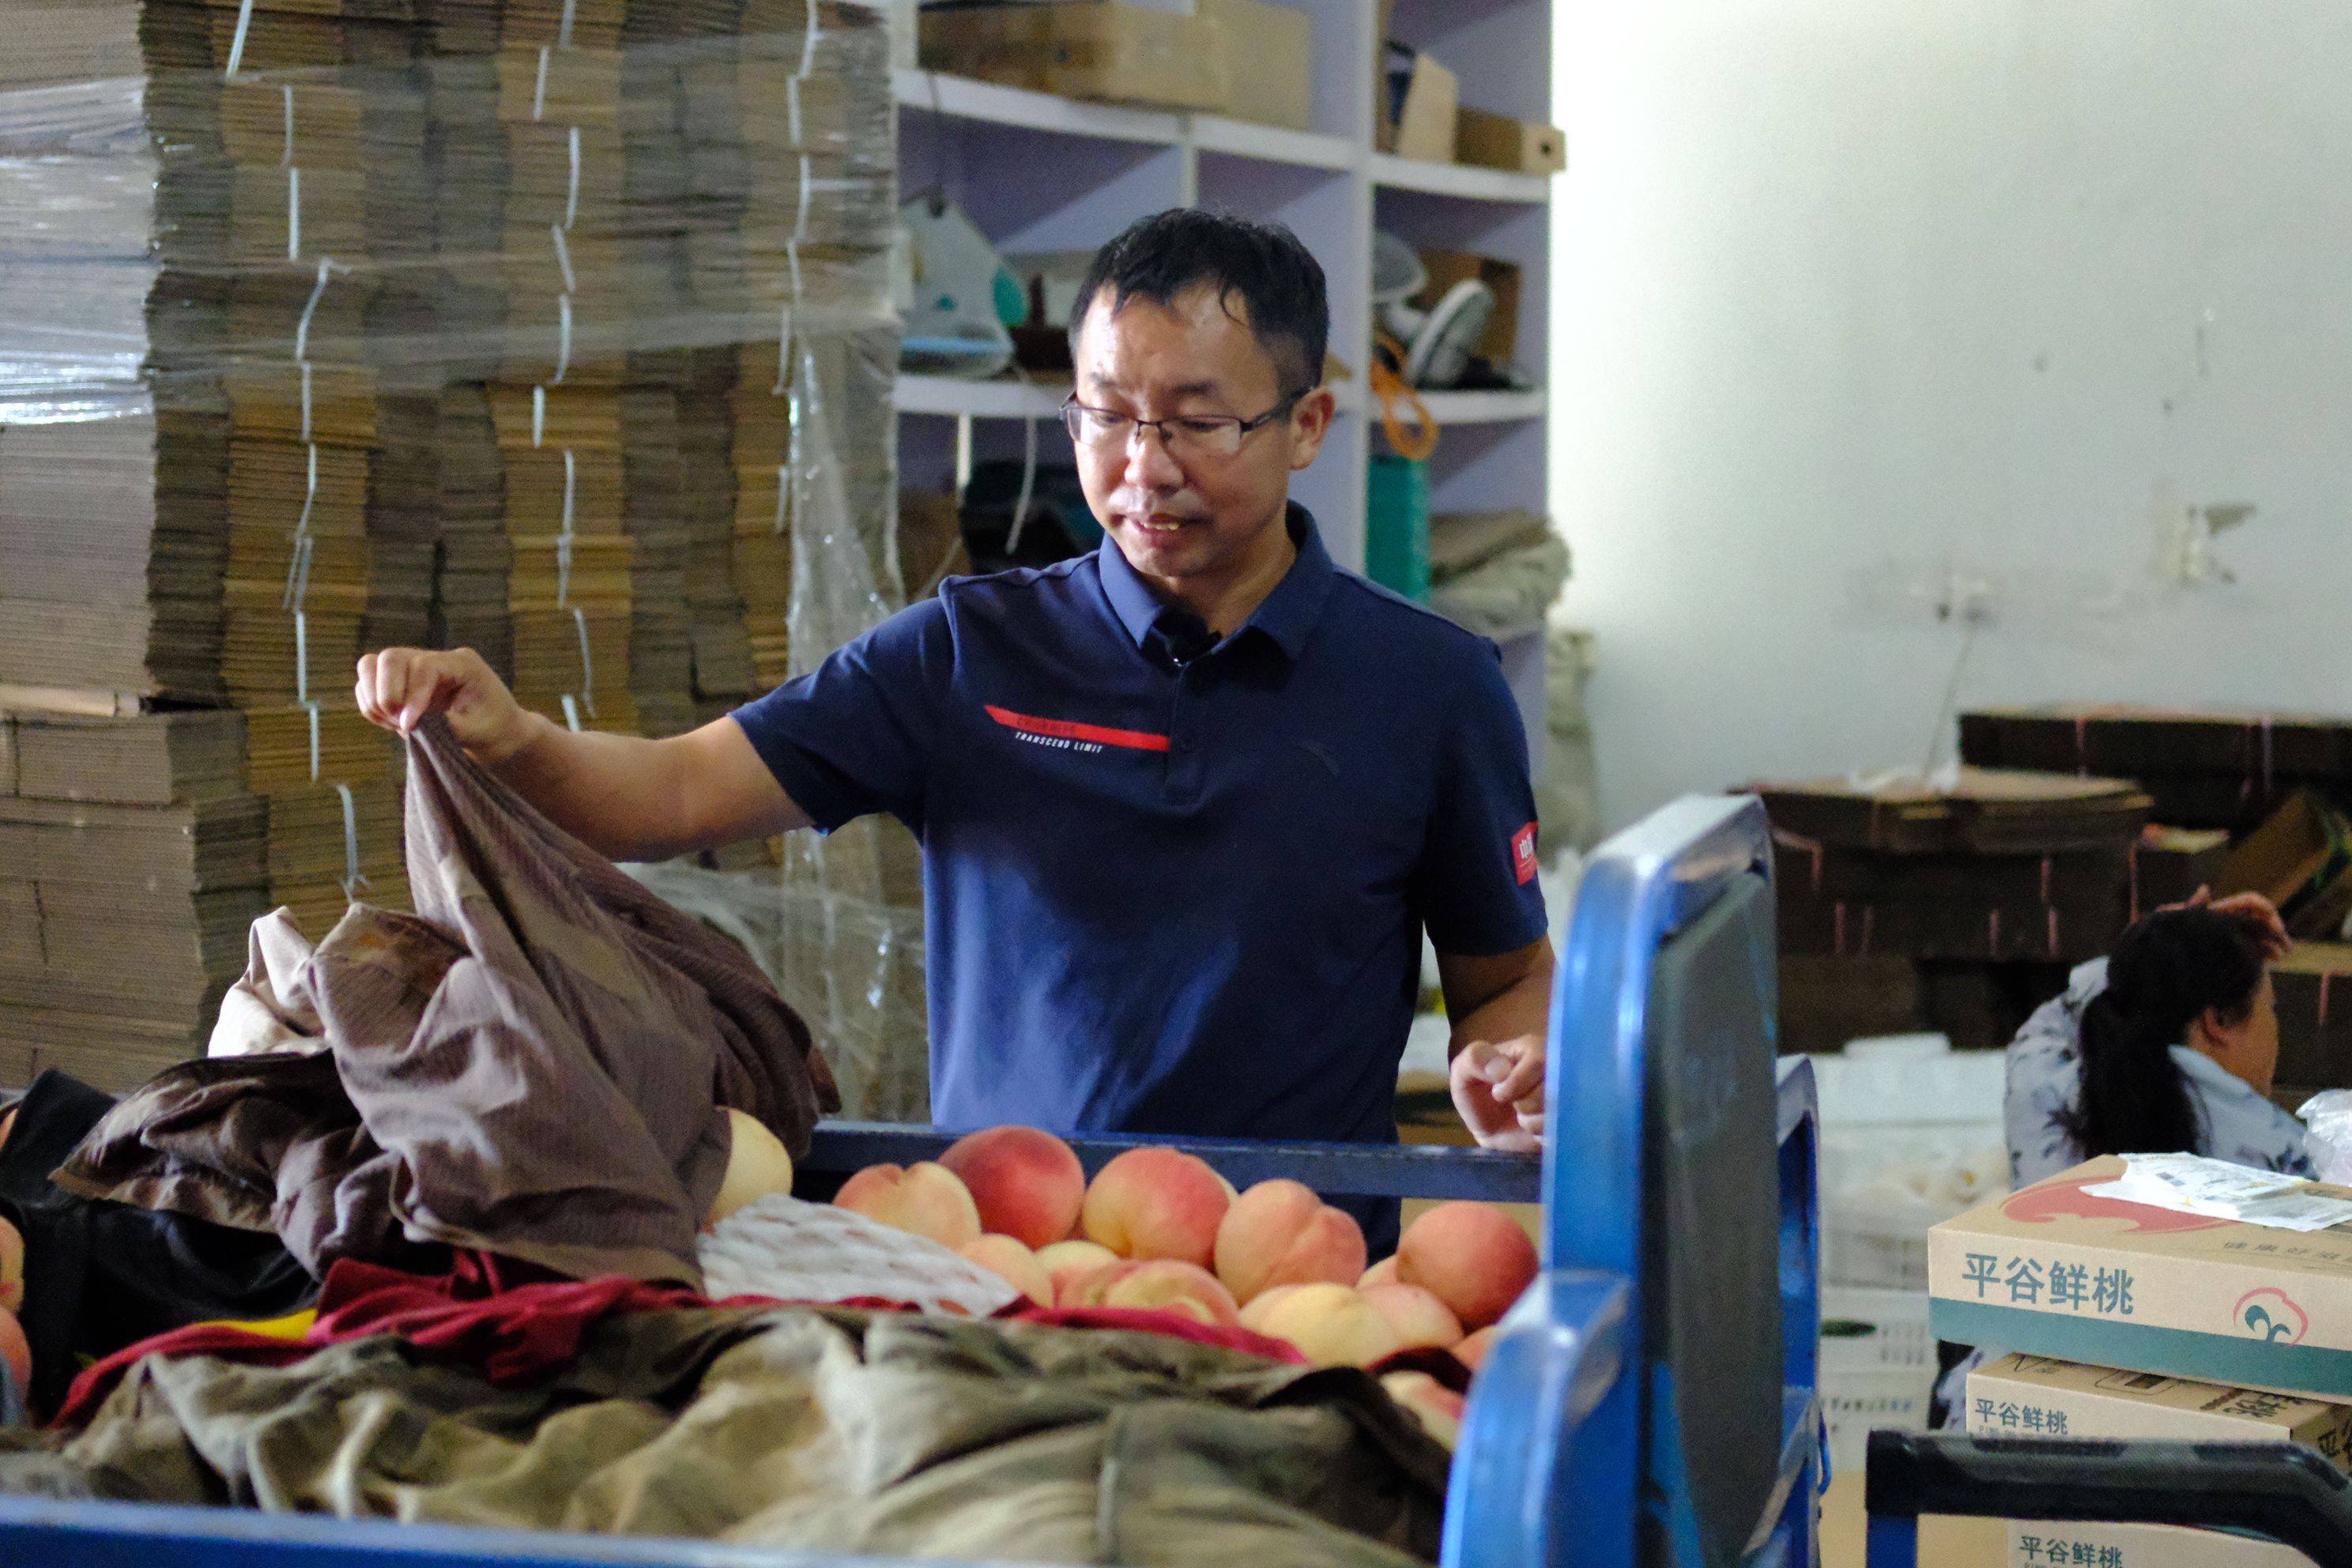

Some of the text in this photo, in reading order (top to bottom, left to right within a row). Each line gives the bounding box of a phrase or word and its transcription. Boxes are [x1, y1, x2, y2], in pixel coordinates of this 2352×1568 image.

[1015, 731, 1103, 753] TRANSCEND LIMIT
[1962, 1253, 2134, 1315] 平谷鲜桃
[1975, 1398, 2068, 1435] 平谷鲜桃
[2018, 1536, 2124, 1568] 平谷鲜桃
